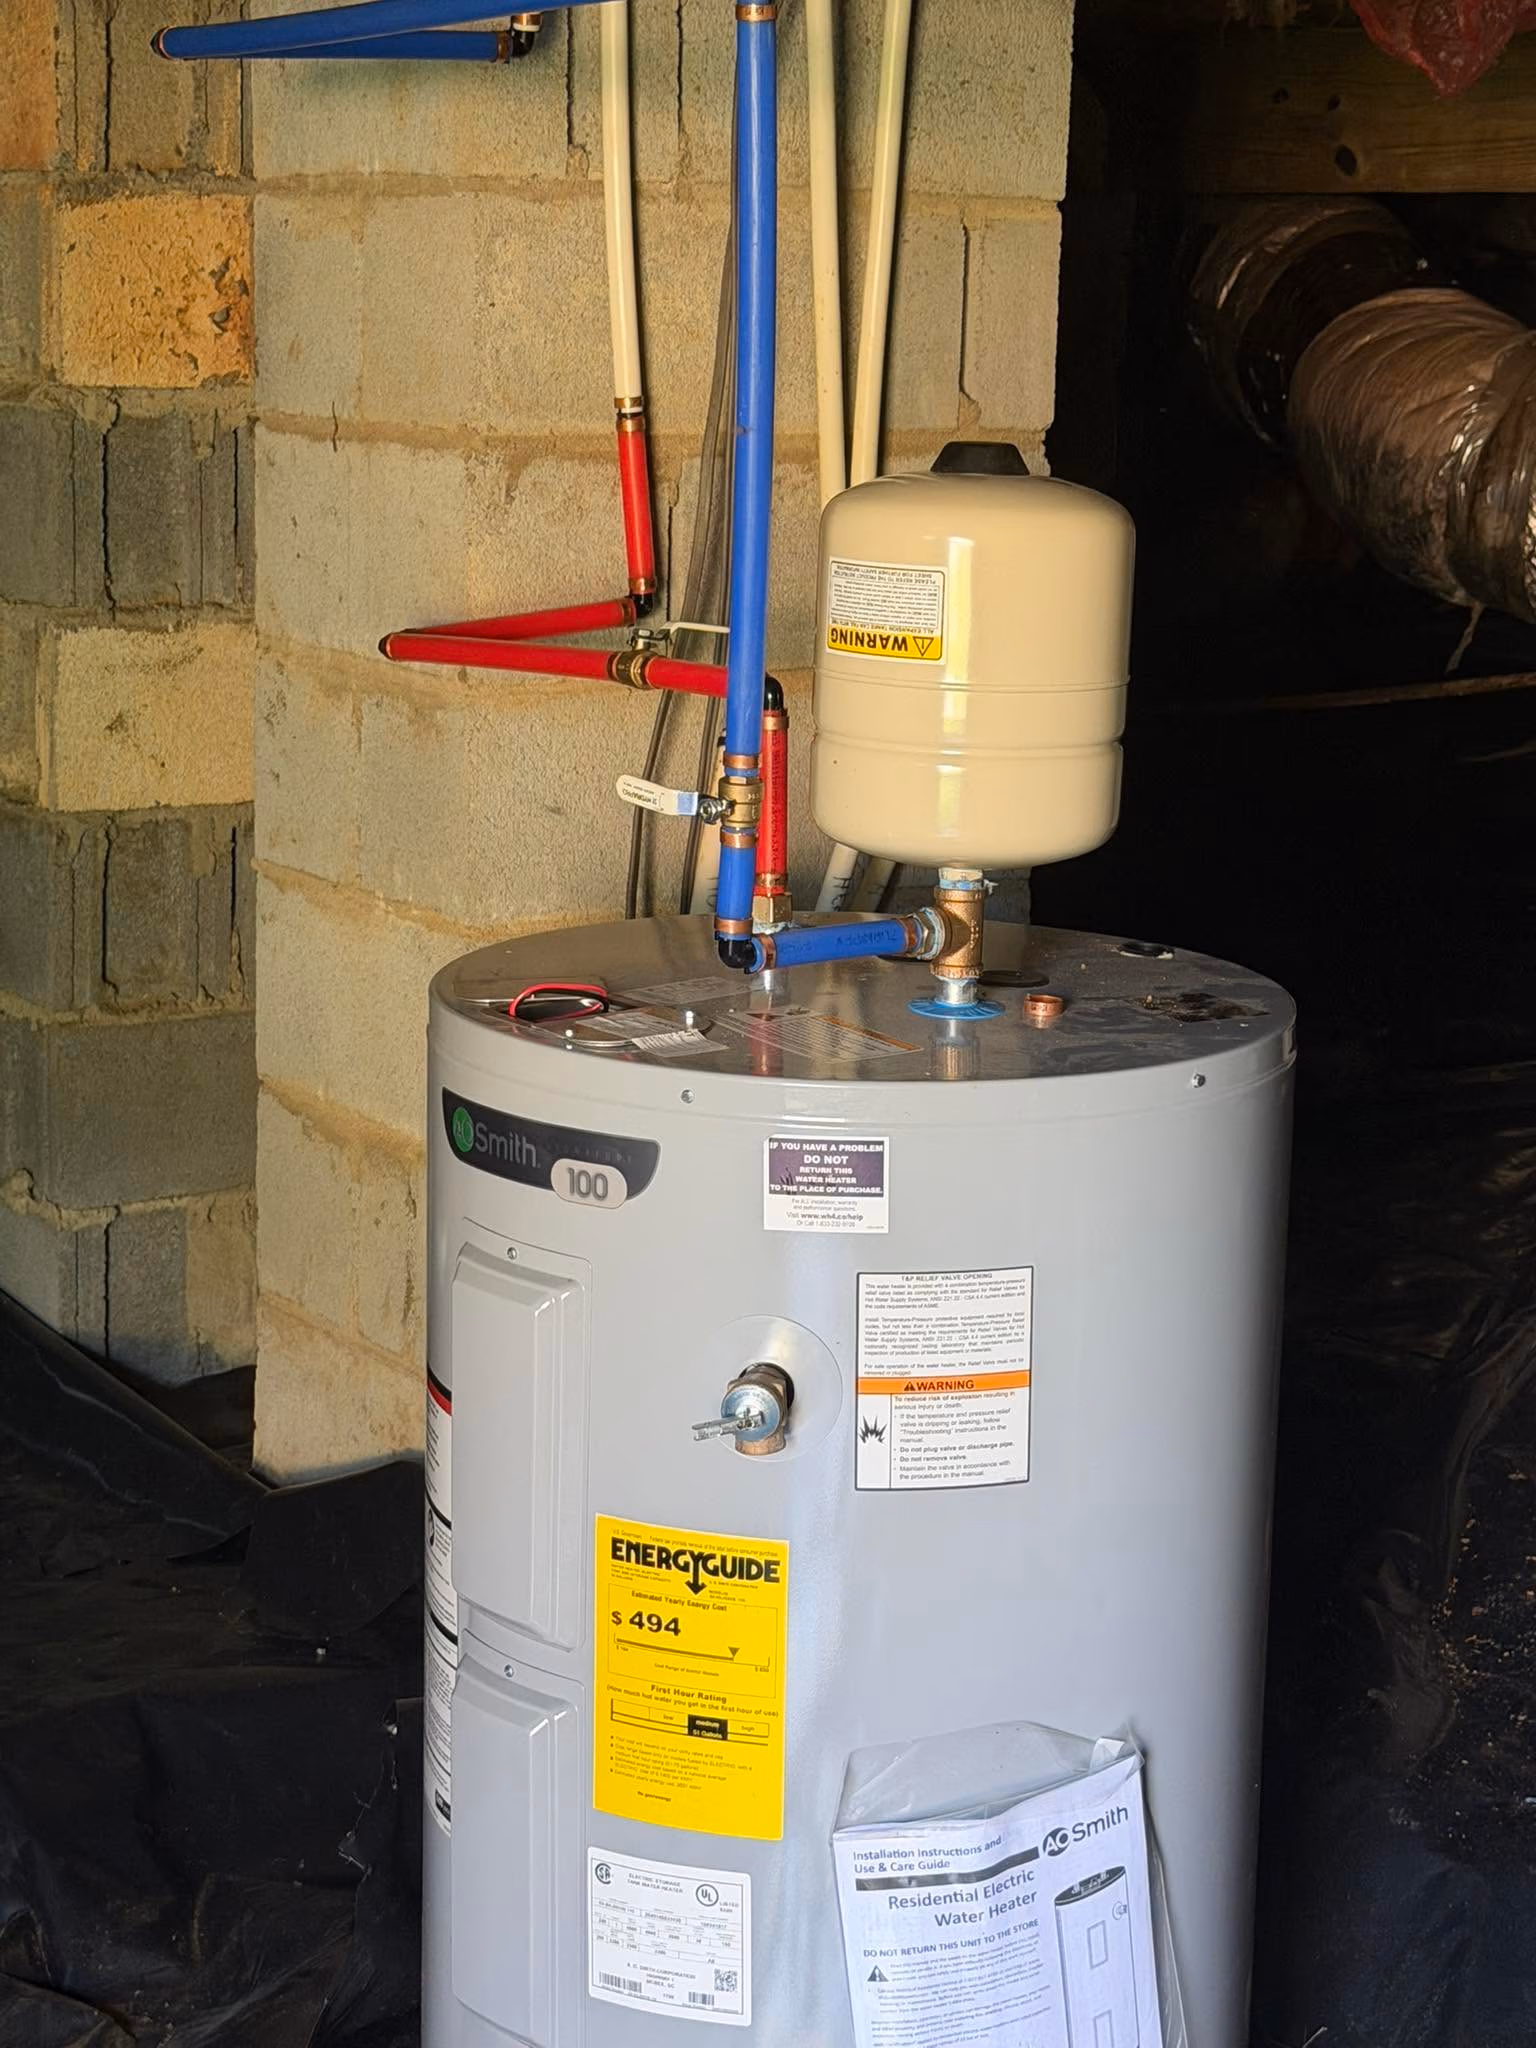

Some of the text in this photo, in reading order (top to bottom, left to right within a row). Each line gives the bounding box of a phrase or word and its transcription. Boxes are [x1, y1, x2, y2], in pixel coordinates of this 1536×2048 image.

[831, 628, 908, 651] WARNING
[770, 1142, 779, 1150] IF
[781, 1142, 800, 1150] YOU
[803, 1143, 828, 1151] HAVE
[839, 1144, 883, 1152] PROBLEM
[799, 1166, 832, 1174] RETURN
[803, 1155, 848, 1164] DO NOT
[567, 1167, 608, 1200] 100
[782, 1184, 797, 1192] THE
[799, 1185, 825, 1193] PLACE
[795, 1175, 857, 1184] WATER HEATER
[917, 1380, 975, 1391] WARNING
[611, 1536, 781, 1588] ENERGYGUIDE
[631, 1590, 727, 1612] Estimated Yearly Energy Cost
[611, 1610, 681, 1636] $ 494
[650, 1684, 727, 1704] First Hour Rating
[736, 1706, 752, 1714] hour
[1072, 1806, 1128, 1842] Smith
[853, 1836, 1002, 1861] Installation Instructions and
[854, 1859, 951, 1874] Use & Care Guide
[888, 1869, 1035, 1910] Residential Electric
[934, 1891, 1037, 1927] Water Heater
[863, 1919, 1039, 1957] DO NOT RETURN THIS UNIT TO THE STORE
